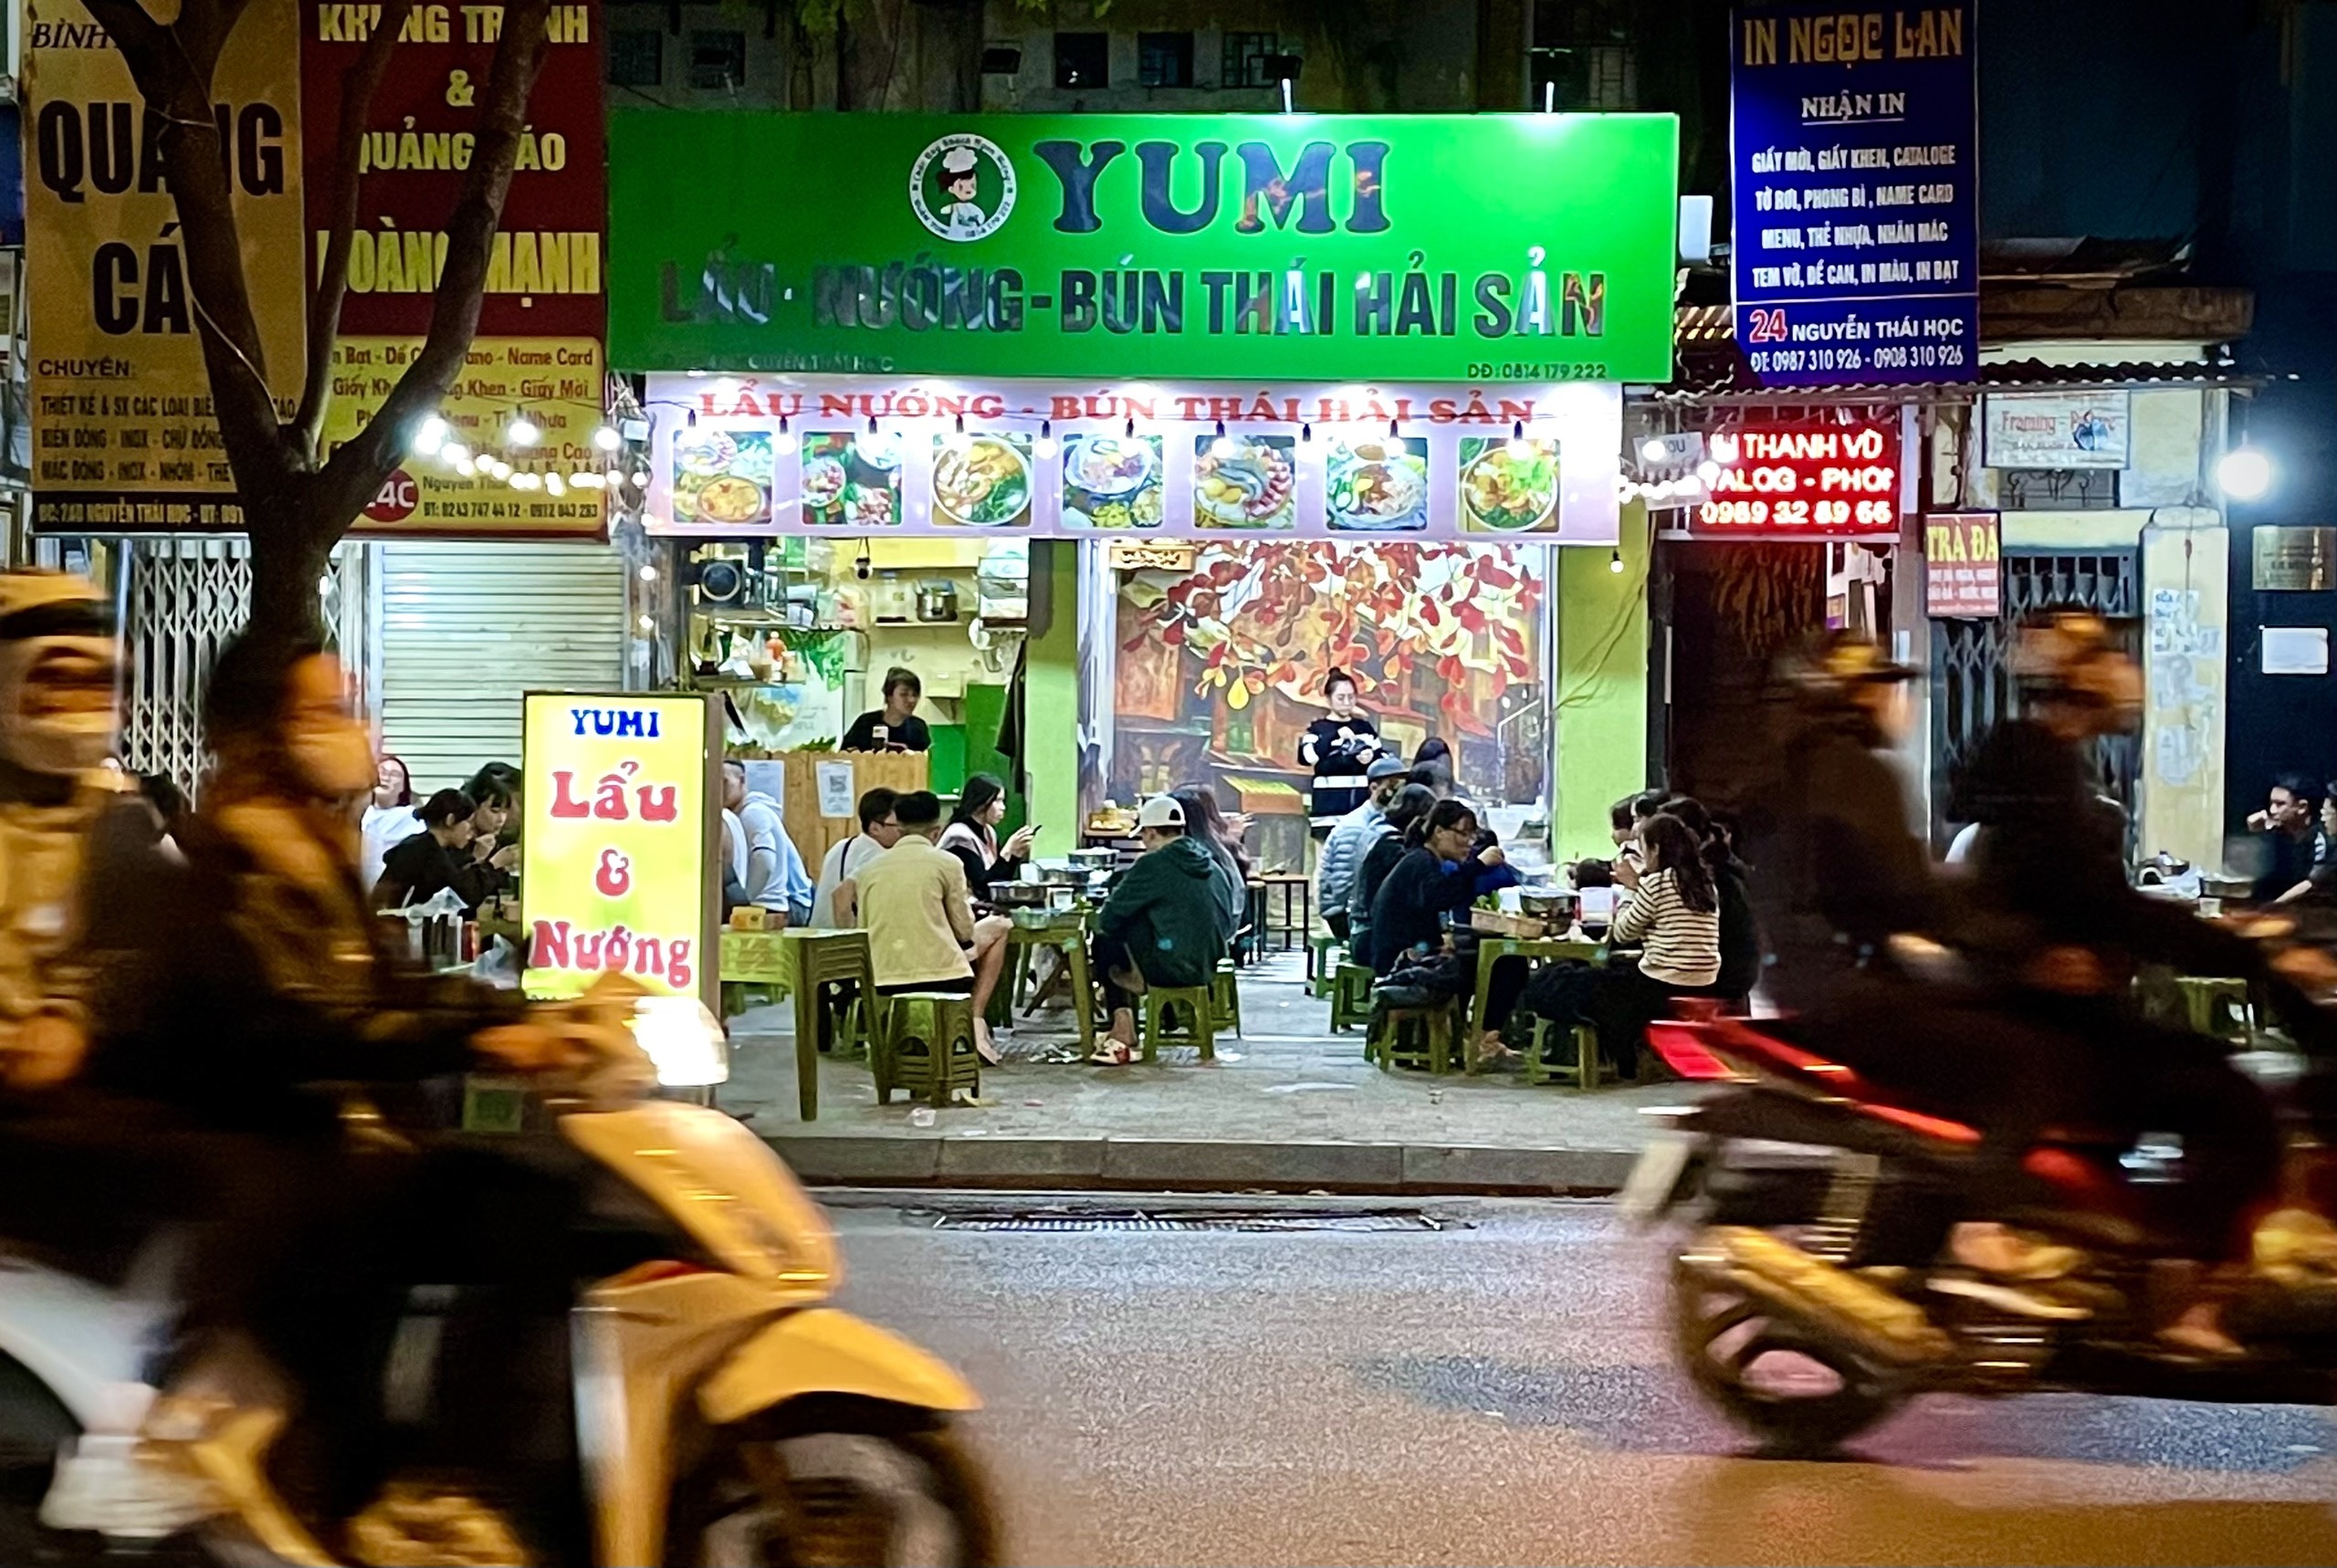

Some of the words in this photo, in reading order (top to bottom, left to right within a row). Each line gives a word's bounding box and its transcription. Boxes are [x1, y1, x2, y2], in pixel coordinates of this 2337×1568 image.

[320, 4, 450, 43] KHNG
[459, 5, 589, 43] TRNH
[1744, 18, 1777, 66] IN
[1788, 13, 1883, 68] NGỌC
[1894, 8, 1962, 58] LAN
[445, 69, 475, 107] &
[1801, 89, 1872, 121] NHẬN
[1879, 92, 1905, 114] IN
[37, 99, 284, 204] QUG
[513, 124, 566, 172] ÁO
[1032, 139, 1391, 235] YUMI
[1804, 187, 1849, 209] PHONG
[1876, 184, 1915, 206] NAME
[1918, 183, 1954, 204] CARD
[93, 221, 192, 335] CÁ
[814, 250, 1024, 331] NƯỚNG
[1060, 254, 1183, 335] BÚN
[1200, 256, 1335, 336] THÁI
[1355, 250, 1457, 337] HẢI
[1472, 246, 1605, 339] SẢN
[1752, 267, 1781, 287] TEM
[1749, 308, 1787, 343] 24
[1792, 314, 1871, 342] NGUYỄN
[1875, 315, 1918, 339] THÁI
[1923, 319, 1964, 341] HỌC
[465, 350, 494, 365] ano
[508, 346, 552, 365] Name
[557, 346, 593, 365] Card
[1545, 363, 1570, 379] 179
[1574, 362, 1607, 379] 222
[1772, 349, 1807, 372] 0987
[1808, 349, 1834, 371] 310
[1836, 348, 1862, 370] 926
[1910, 345, 1935, 367] 310
[1937, 344, 1964, 366] 926
[467, 379, 507, 396] Khen
[699, 378, 803, 417] LẨU
[819, 388, 1006, 419] NƯỚNG
[1050, 389, 1157, 421] BÚN
[1174, 390, 1300, 422] THÁI
[1318, 389, 1412, 425] HẢI
[1428, 389, 1536, 425] SẢN
[1744, 433, 1837, 459] THANH
[1773, 500, 1808, 525] 32
[1927, 516, 1967, 562] TRÀ
[1971, 516, 1999, 562] ĐÁ
[571, 708, 660, 738] YUMI
[550, 760, 677, 823] Lẩu
[596, 849, 630, 897] &
[528, 919, 692, 989] Nướng
